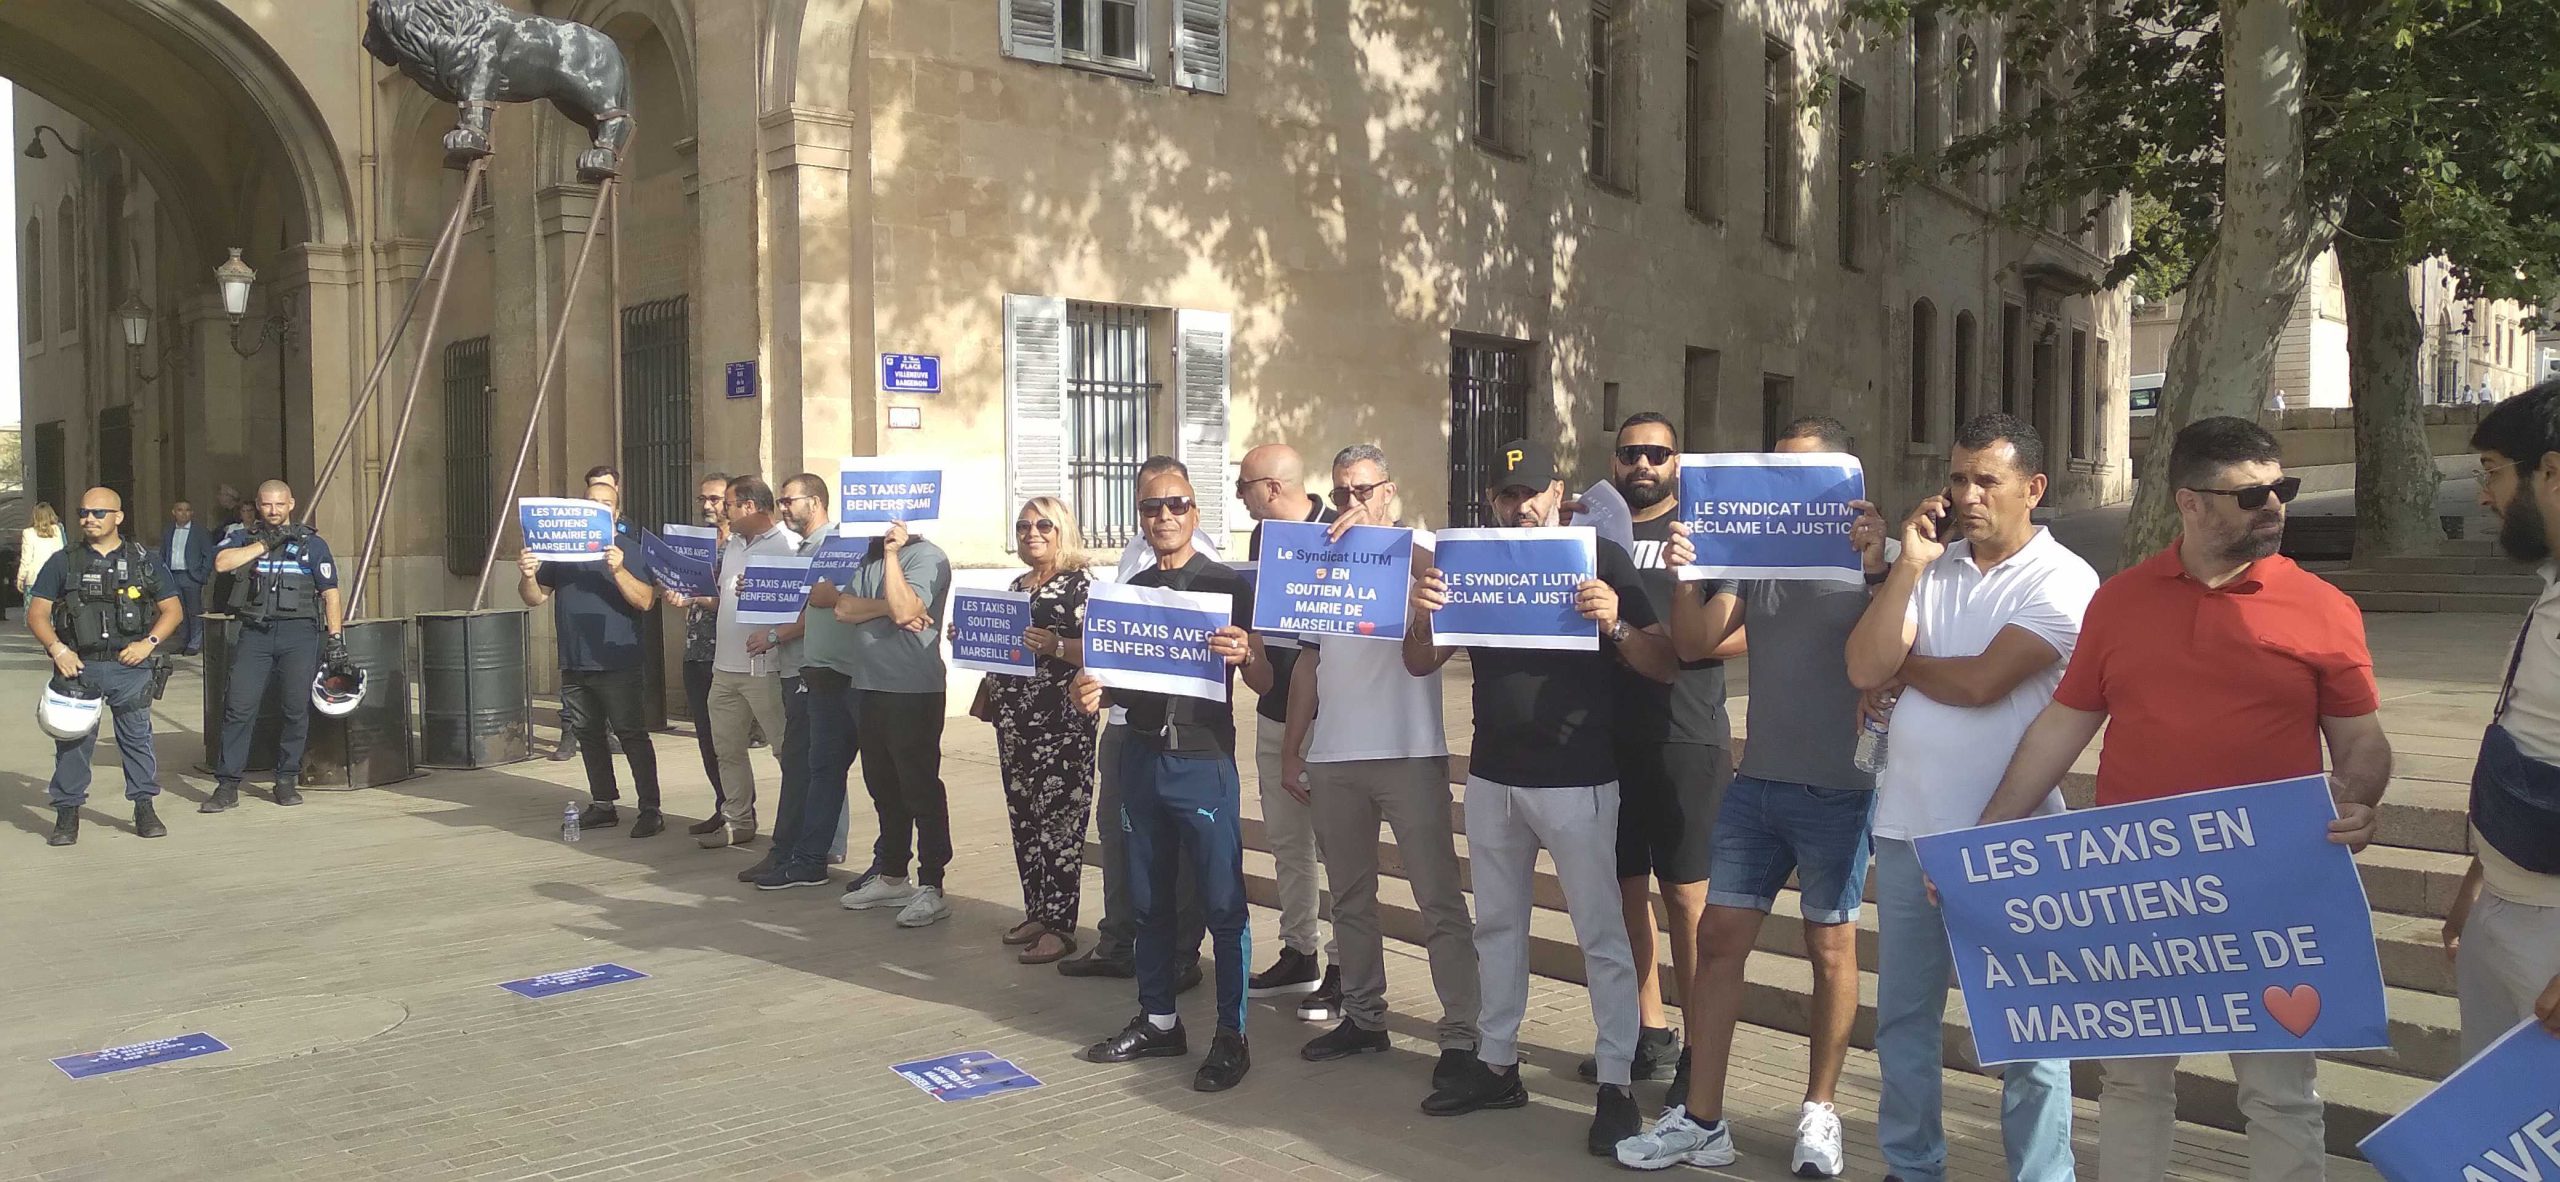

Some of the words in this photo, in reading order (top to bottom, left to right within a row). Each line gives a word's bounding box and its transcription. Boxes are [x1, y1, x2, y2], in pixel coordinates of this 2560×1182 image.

[1506, 449, 1524, 471] P
[843, 484, 867, 496] LES
[869, 483, 907, 495] TAXIS
[908, 482, 936, 494] AVEC
[846, 499, 904, 511] BENFERS
[906, 497, 931, 510] SAMI
[1695, 501, 1714, 515] LE
[1717, 501, 1802, 516] SYNDICAT
[1806, 502, 1854, 516] LUTM
[531, 507, 550, 516] LES
[551, 507, 582, 517] TAXIS
[583, 508, 598, 517] EN
[537, 519, 588, 528] SOUTIENS
[1766, 521, 1788, 535] LA
[1791, 522, 1853, 535] JUSTIC
[536, 531, 550, 539] LA
[588, 530, 602, 539] DE
[532, 542, 586, 551] MARSEILLE
[1277, 547, 1294, 560] Le
[1295, 549, 1349, 564] Syndicat
[1352, 551, 1393, 567] LUTM
[1331, 567, 1350, 581] EN
[1444, 573, 1462, 586] LE
[1464, 573, 1539, 586] SYNDICAT
[1542, 573, 1585, 586] LUTM
[744, 578, 754, 588] ES
[755, 579, 780, 589] TAXIS
[781, 580, 804, 590] AVEC
[1285, 582, 1342, 598] SOUTIEN
[1343, 583, 1355, 599] À
[1358, 587, 1377, 600] LA
[740, 592, 777, 602] BENFERS
[778, 593, 800, 603] SAMI
[1508, 591, 1527, 604] LA
[1530, 591, 1584, 604] JUSTIC
[962, 600, 978, 612] LES
[980, 601, 1005, 614] TAXIS
[1006, 604, 1017, 616] EN
[1295, 600, 1342, 616] MAIRIE
[1344, 604, 1364, 617] DE
[967, 616, 1011, 630] SOUTIENS
[1087, 617, 1117, 634] LES
[1121, 620, 1169, 640] TAXIS
[1172, 626, 1215, 642] AVEC
[1279, 616, 1355, 633] MARSEILLE
[957, 628, 965, 641] À
[966, 631, 978, 643] LA
[1011, 635, 1024, 647] DE
[960, 645, 1009, 660] MARSEILLE
[1092, 638, 1165, 658] BENFERS
[1169, 646, 1211, 663] SAMI
[1960, 838, 2041, 884] LES
[2045, 817, 2182, 871] TAXIS
[2189, 806, 2256, 854] EN
[2004, 874, 2230, 936] SOUTIENS
[1980, 946, 2015, 990] À
[2020, 950, 2079, 987] LA
[2079, 933, 2249, 983] MAIRIE
[2252, 925, 2326, 970] DE
[2004, 992, 2257, 1044] MARSEILLE
